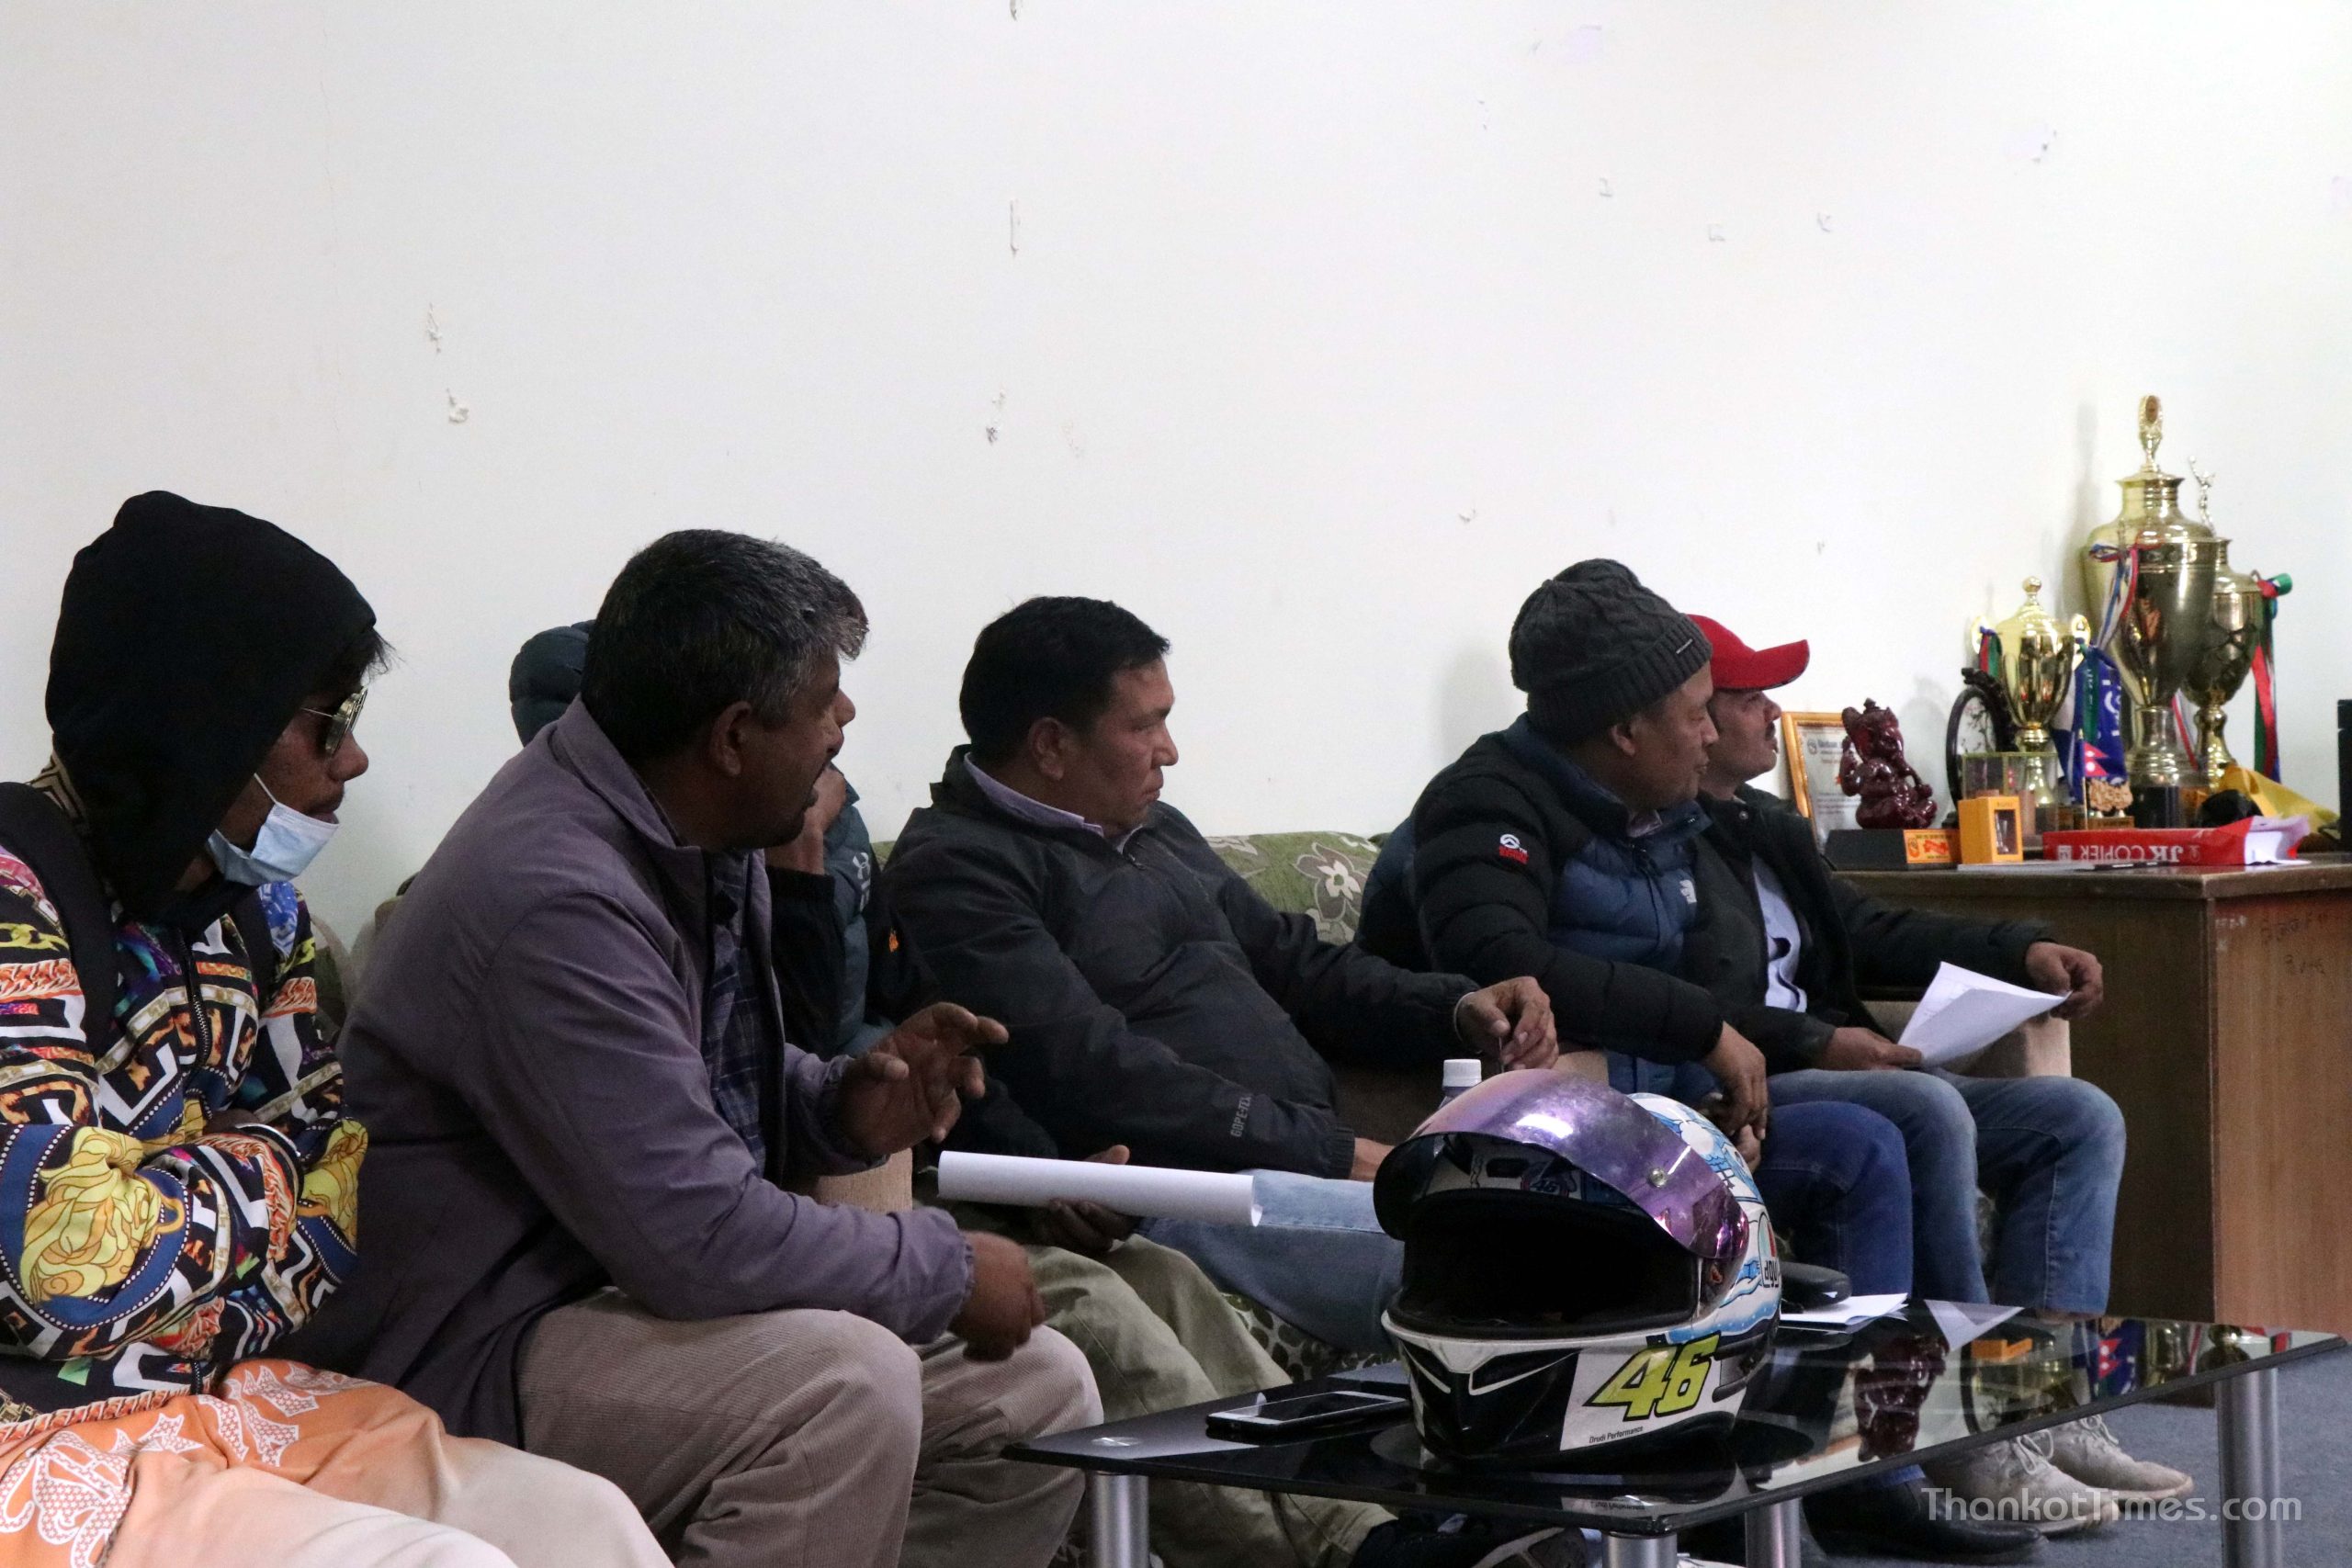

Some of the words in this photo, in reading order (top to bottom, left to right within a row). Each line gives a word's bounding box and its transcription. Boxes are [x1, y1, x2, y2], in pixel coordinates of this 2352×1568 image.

[2081, 844, 2144, 861] COPIER
[2150, 845, 2184, 863] JK
[1582, 1330, 1722, 1422] 46
[1589, 1435, 1606, 1444] Drudi
[1607, 1426, 1644, 1440] Performance
